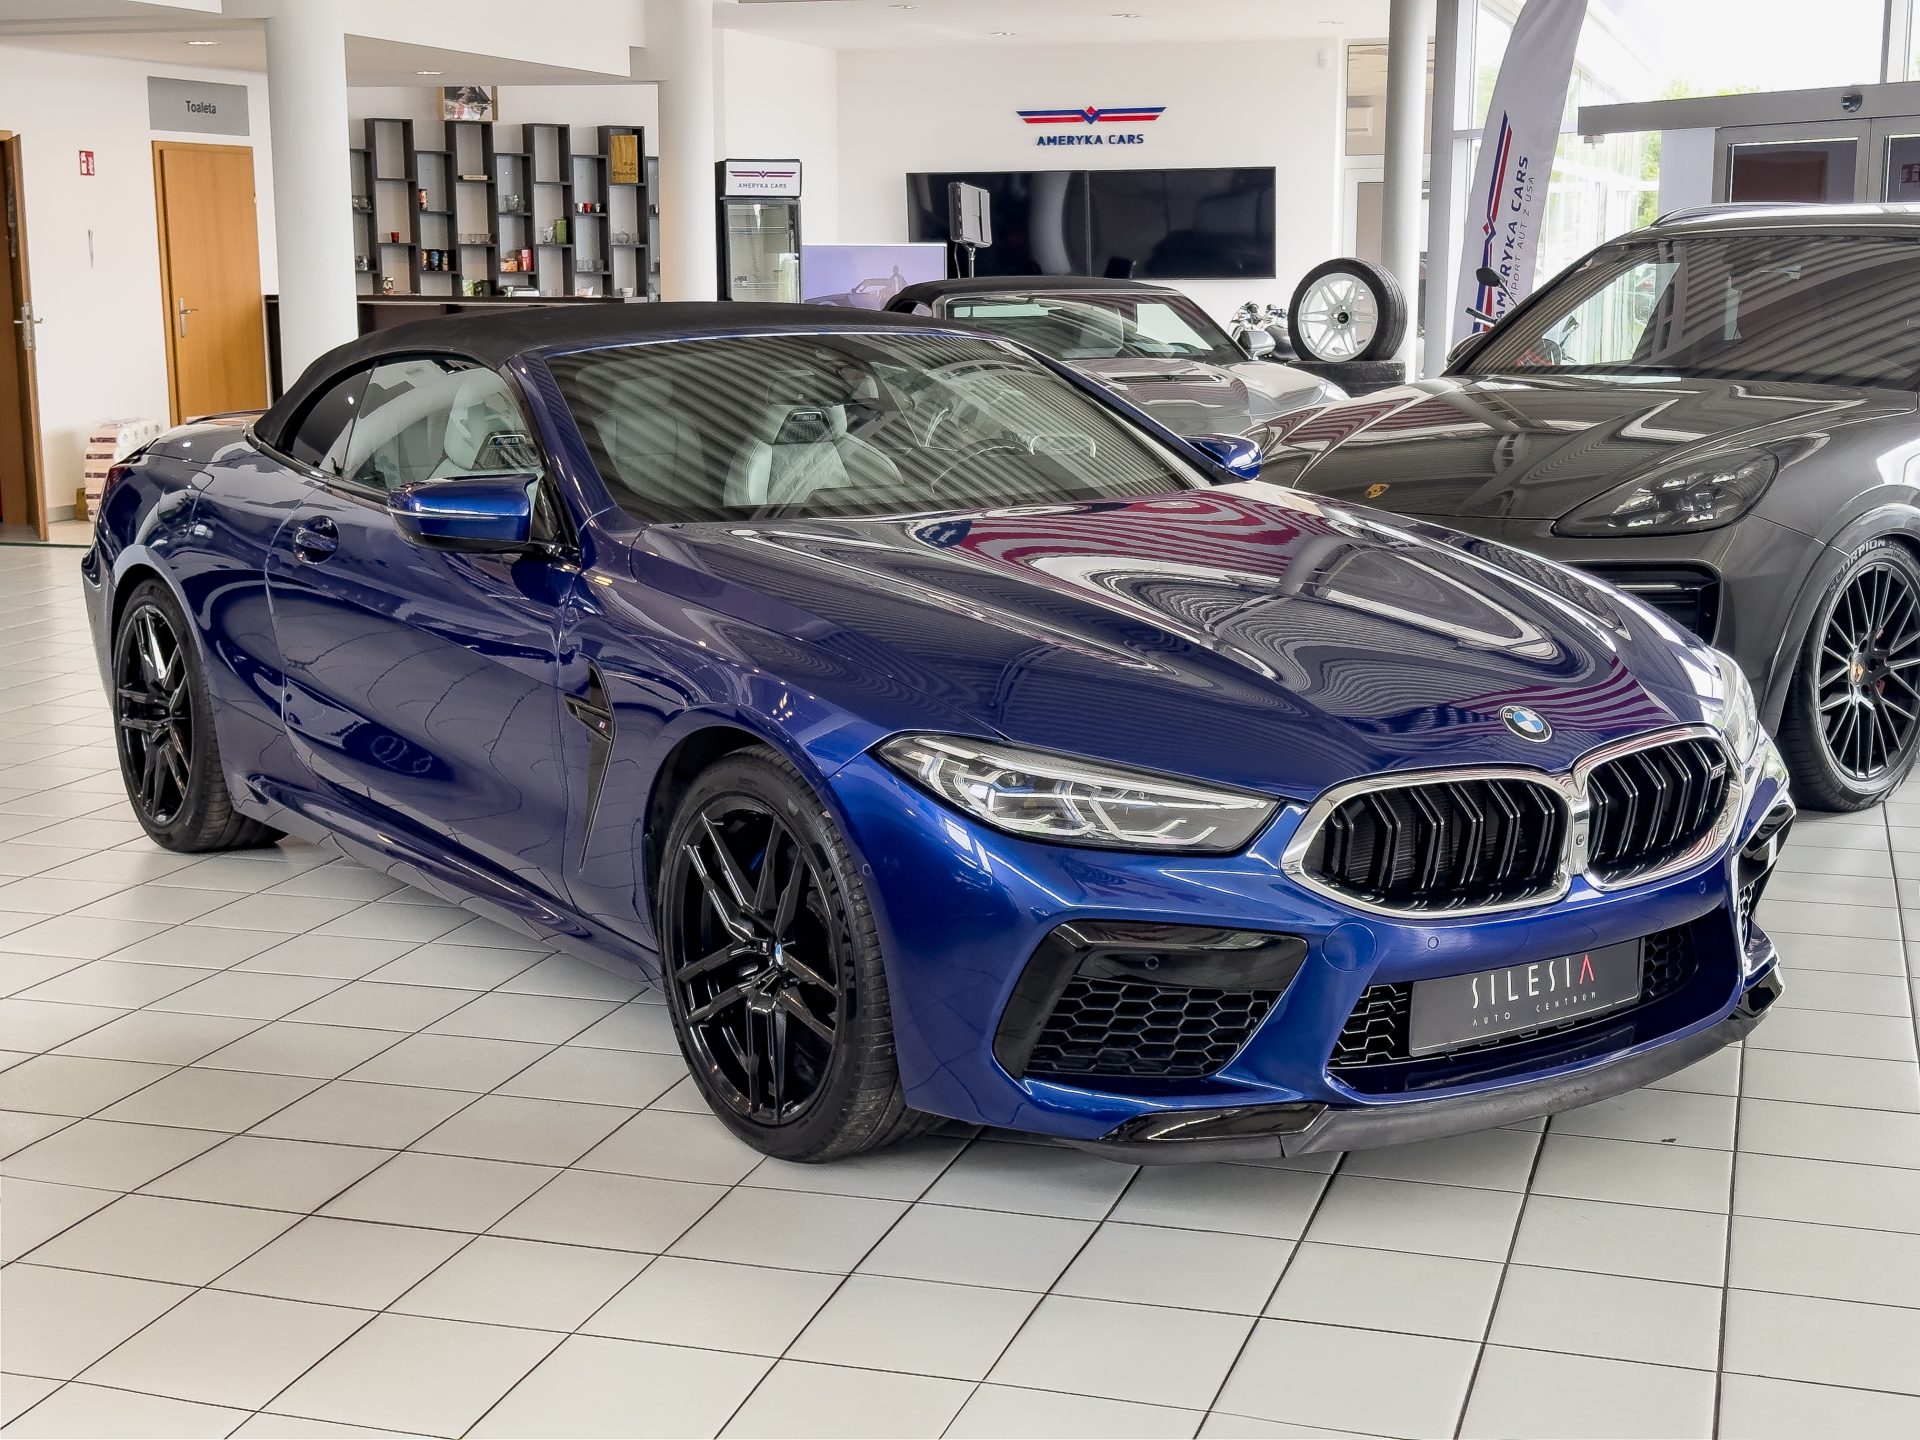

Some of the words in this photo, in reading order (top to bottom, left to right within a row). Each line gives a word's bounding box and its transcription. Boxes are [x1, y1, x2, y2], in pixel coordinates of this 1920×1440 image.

[185, 100, 217, 115] Toaleta
[1036, 134, 1104, 147] AMERYKA
[1108, 133, 1145, 145] CARS
[1495, 221, 1518, 319] AMRYKA
[1510, 155, 1529, 212] CARS
[1516, 221, 1528, 250] AUT
[1524, 176, 1535, 203] USA
[822, 867, 857, 990] NEXEN
[1471, 953, 1595, 1009] SILESIA
[1472, 1011, 1512, 1028] AUTO
[1535, 991, 1596, 1013] CENTRUM
